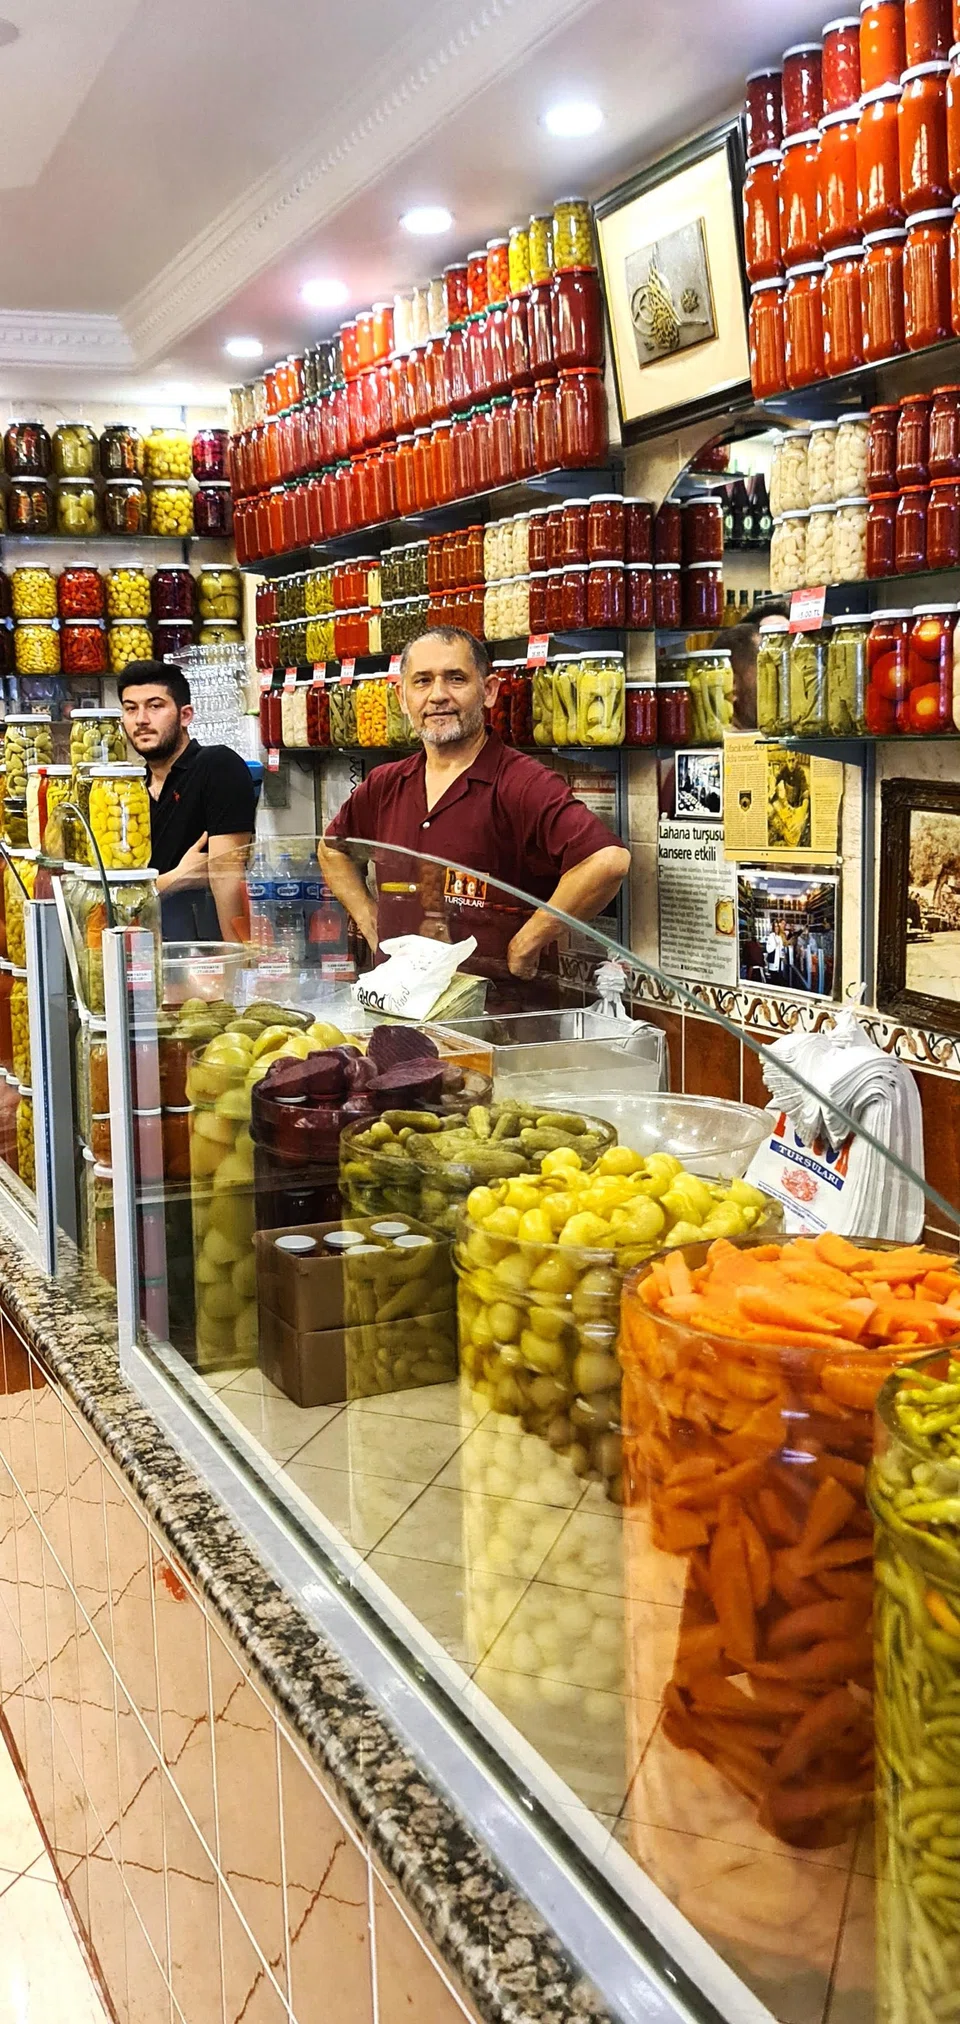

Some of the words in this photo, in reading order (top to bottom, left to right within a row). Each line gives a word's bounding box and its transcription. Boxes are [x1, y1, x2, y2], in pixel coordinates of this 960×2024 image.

[659, 825, 690, 840] Lahana
[692, 828, 724, 844] turşusu
[658, 844, 692, 860] kansere
[695, 846, 716, 860] etkili
[444, 896, 485, 907] TURŞULARI
